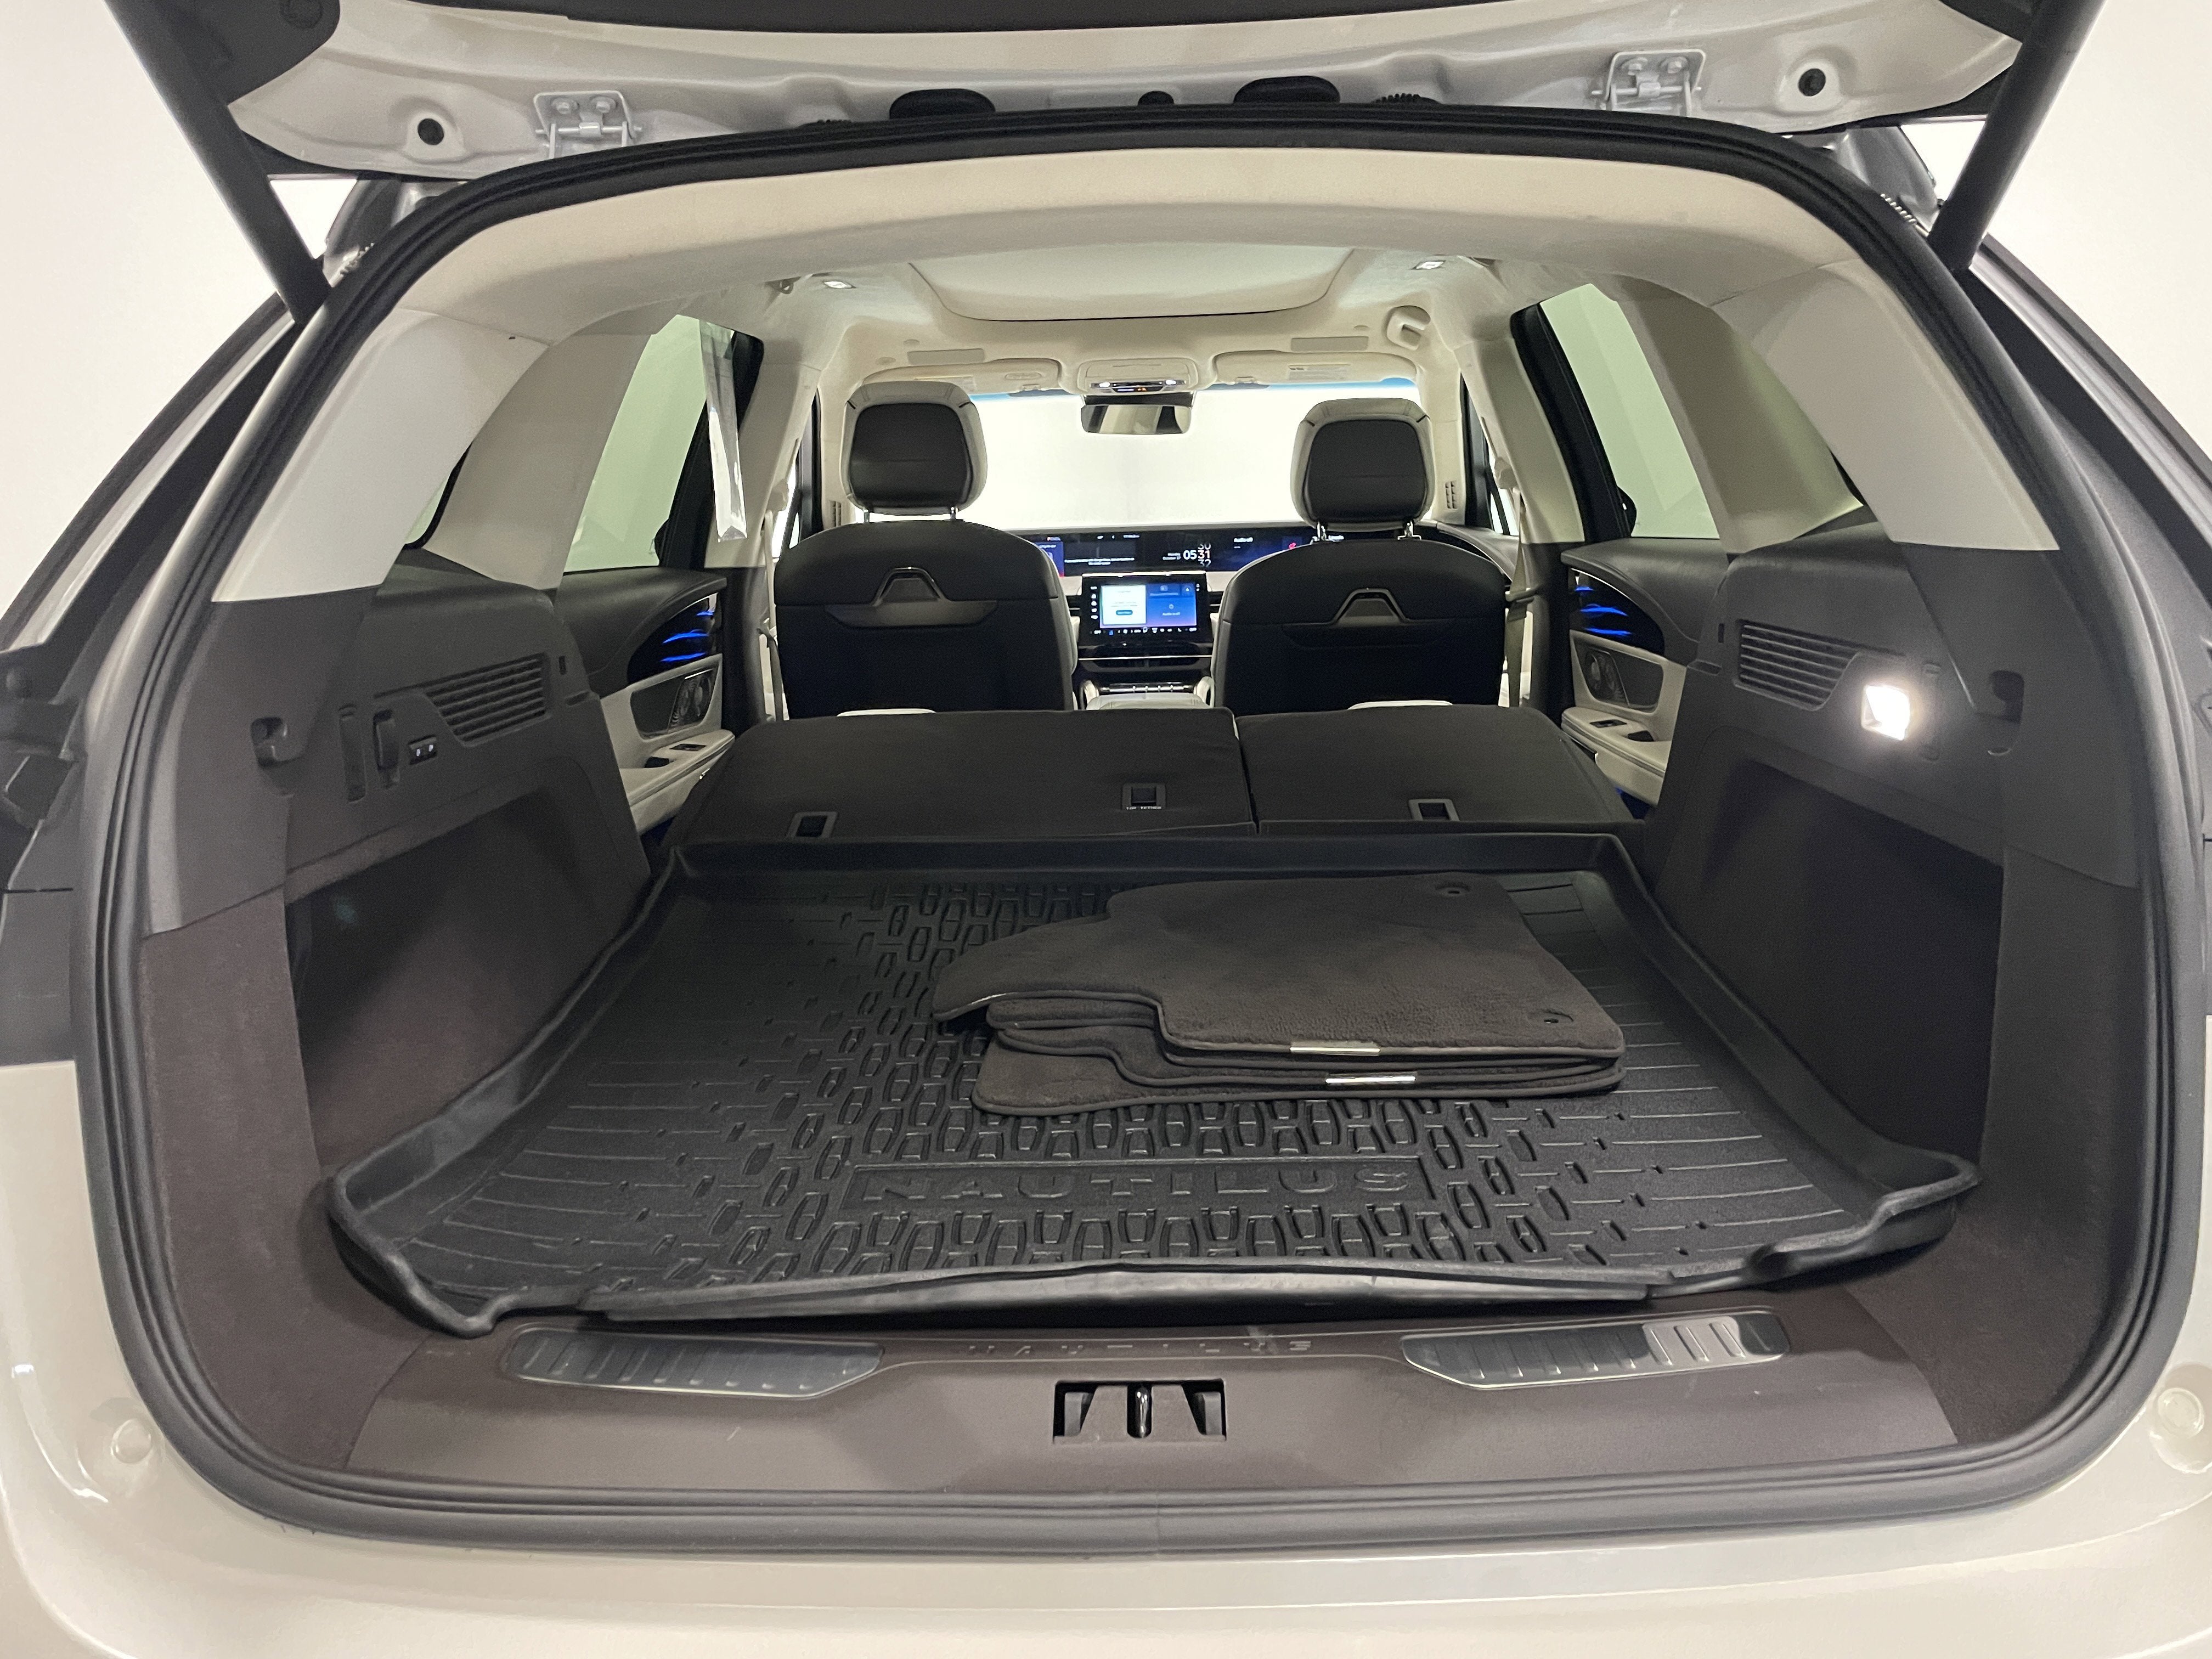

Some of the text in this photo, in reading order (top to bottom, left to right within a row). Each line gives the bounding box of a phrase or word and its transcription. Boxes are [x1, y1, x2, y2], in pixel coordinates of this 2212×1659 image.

[1183, 550, 1197, 560] 05
[1198, 550, 1210, 559] 31
[862, 1170, 1410, 1200] NAUTILUS
